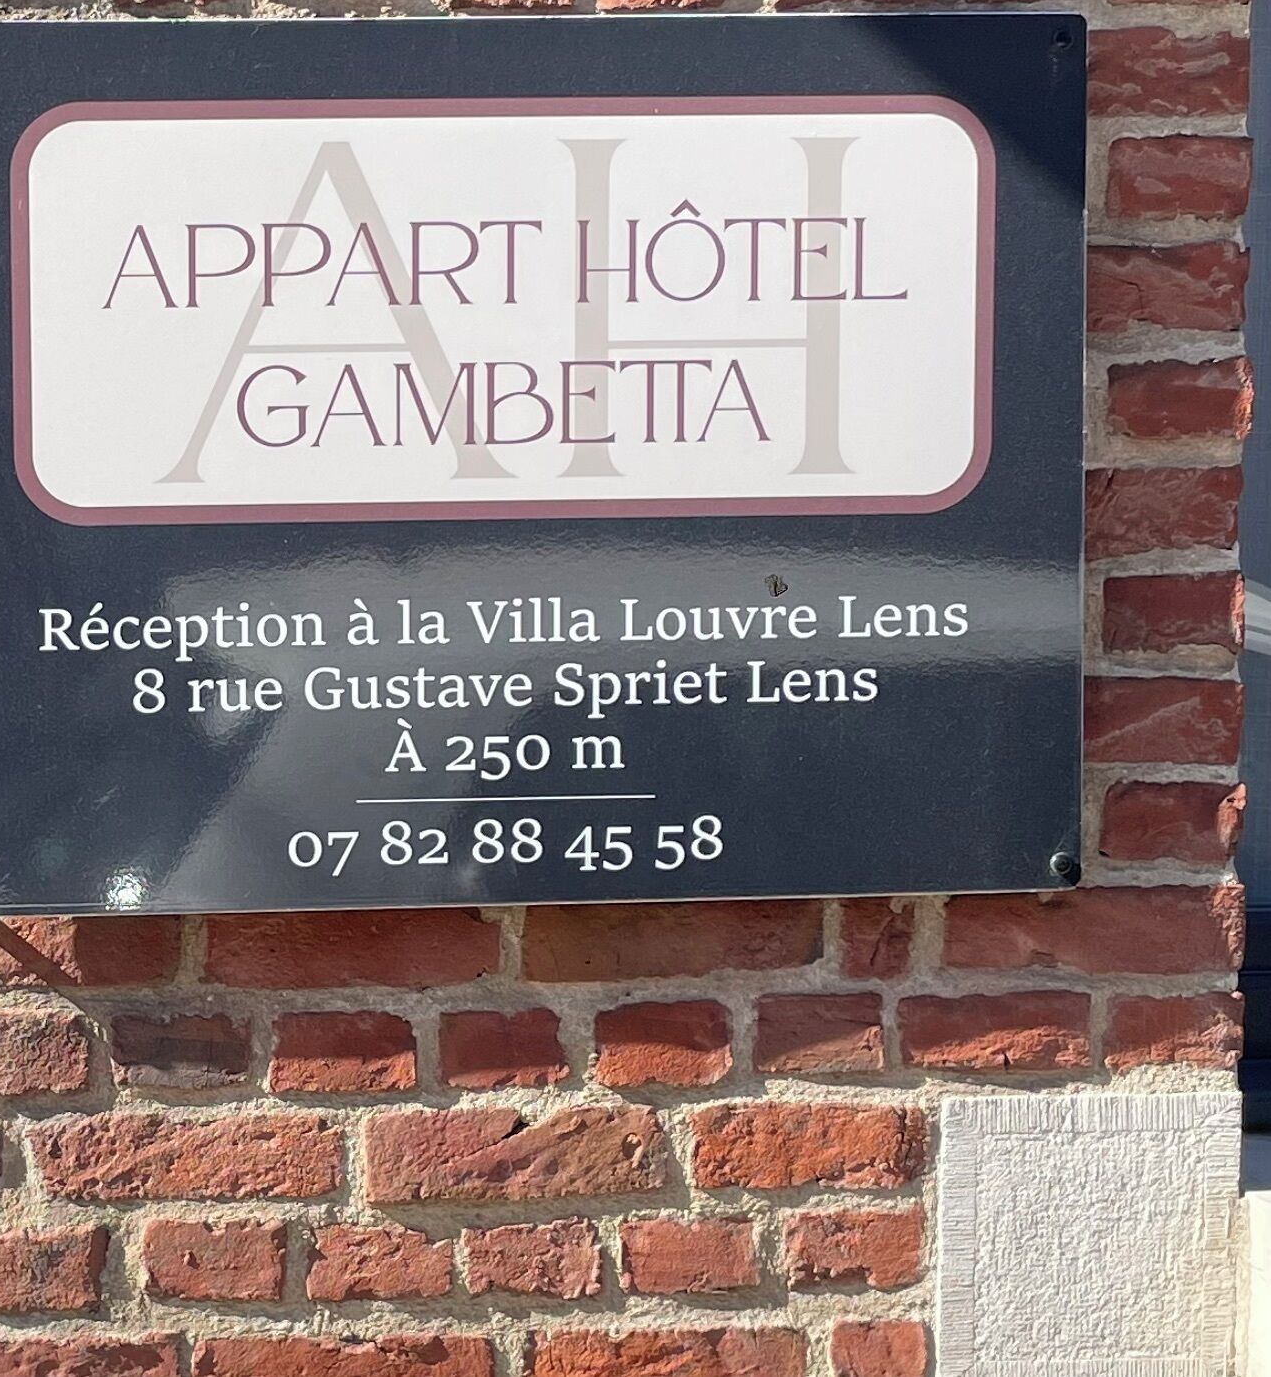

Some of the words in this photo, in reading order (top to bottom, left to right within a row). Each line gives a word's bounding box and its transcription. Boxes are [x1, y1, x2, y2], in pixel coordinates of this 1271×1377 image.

[102, 220, 543, 309] APPART
[576, 198, 909, 304] HÔTEL
[235, 357, 772, 448] GAMBETTA
[38, 602, 326, 661] Réception
[347, 598, 379, 645] à
[397, 599, 450, 644] la
[467, 597, 600, 643] Villa
[620, 599, 817, 641] Louvre
[837, 595, 968, 638] Lens
[132, 668, 166, 713] 8
[187, 676, 284, 712] rue
[304, 666, 532, 711] Gustave
[554, 660, 727, 718] Spriet
[747, 661, 878, 703] Lens
[384, 717, 426, 772] À
[445, 733, 550, 781] 250
[571, 734, 625, 769] m
[288, 831, 359, 877] 07
[380, 821, 449, 865] 82
[472, 818, 544, 863] 88
[564, 826, 633, 871] 45
[655, 815, 724, 870] 58
